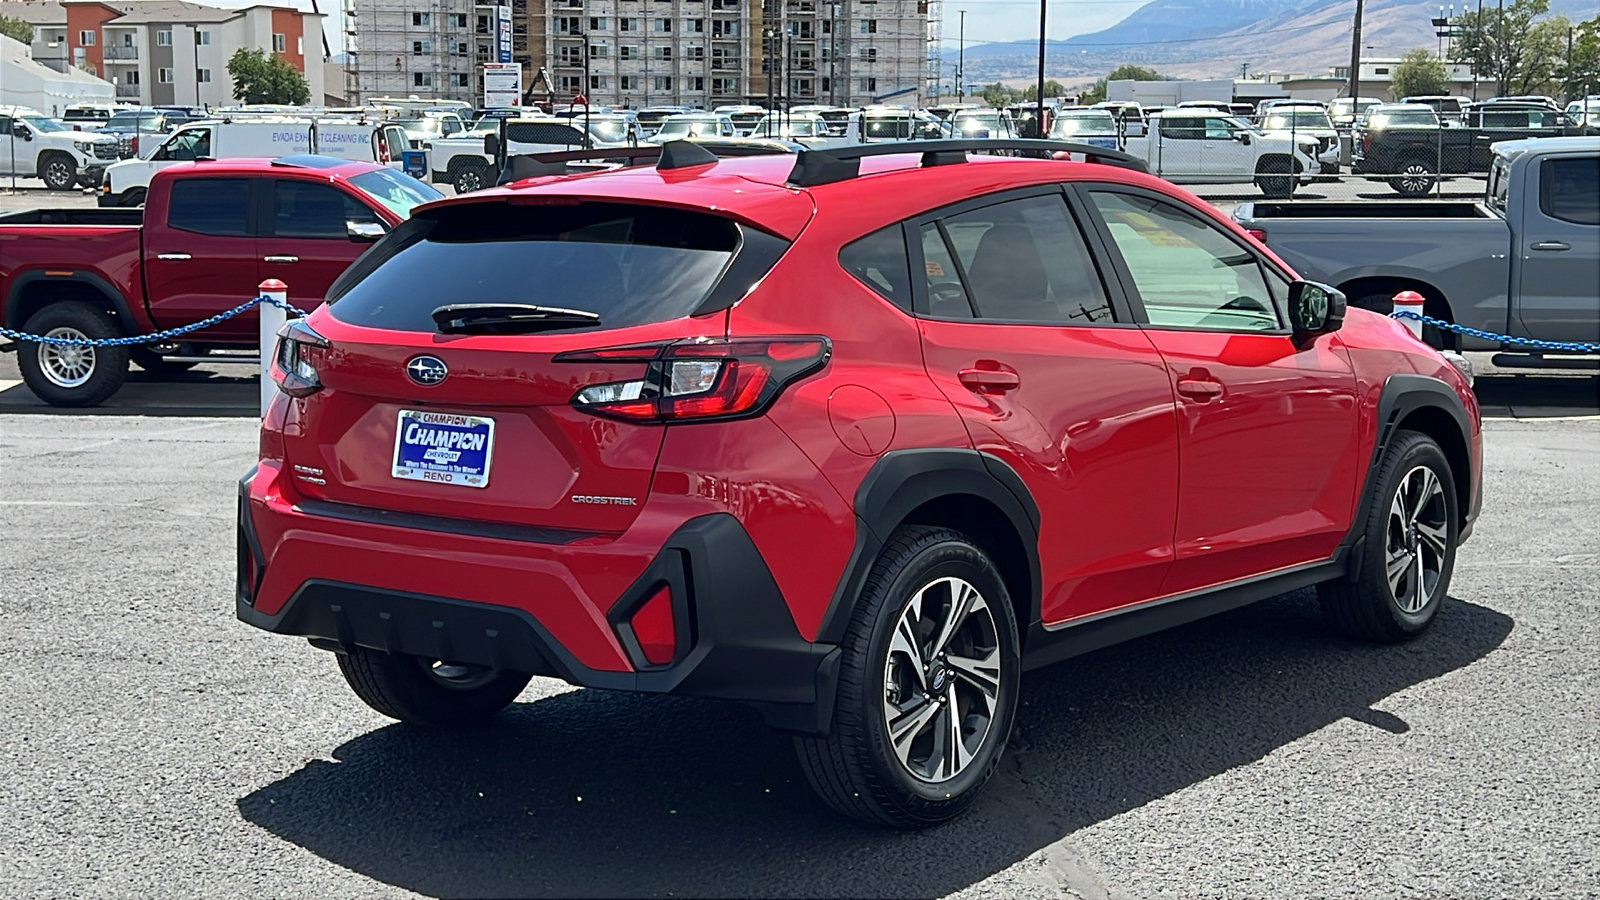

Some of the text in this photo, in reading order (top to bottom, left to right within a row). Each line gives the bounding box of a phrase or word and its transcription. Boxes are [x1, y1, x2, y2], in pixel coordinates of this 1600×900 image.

[295, 132, 324, 143] EXHT
[325, 133, 357, 143] CLEANING
[358, 134, 369, 144] INC
[423, 414, 467, 425] CHAMPION
[405, 423, 485, 451] CHAMPION
[427, 451, 458, 459] CHEVROLET
[423, 472, 453, 481] RENO
[571, 496, 637, 505] CROSSTREK
